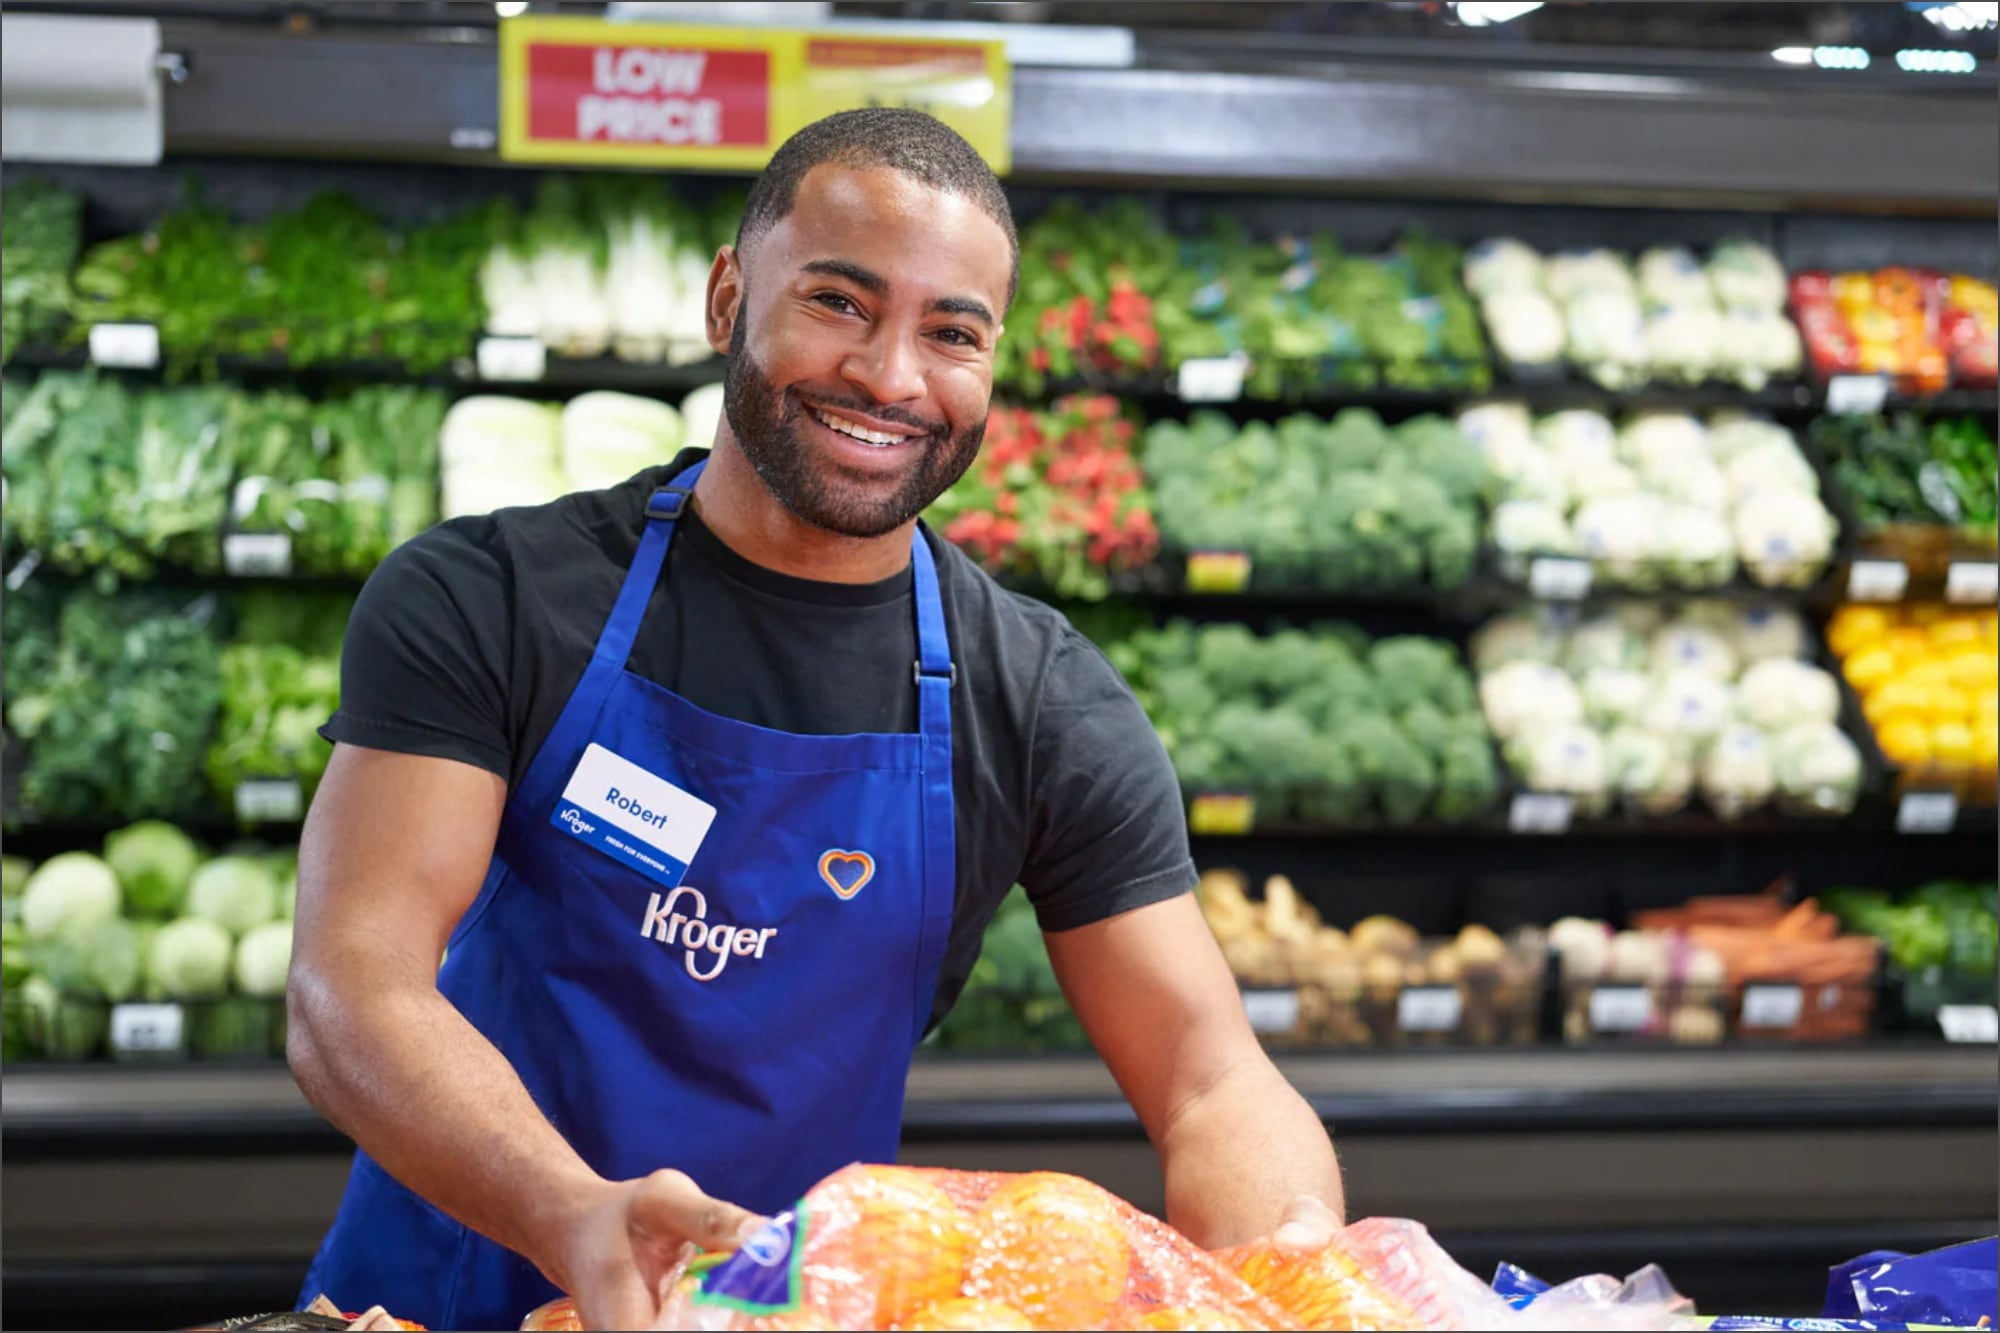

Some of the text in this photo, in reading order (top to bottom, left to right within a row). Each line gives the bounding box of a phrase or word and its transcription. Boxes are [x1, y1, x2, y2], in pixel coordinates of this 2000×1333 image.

[595, 48, 708, 94] LOW
[577, 96, 722, 143] PRICE
[560, 809, 596, 834] Kroger
[605, 787, 667, 829] Robert
[640, 886, 778, 981] Kroger
